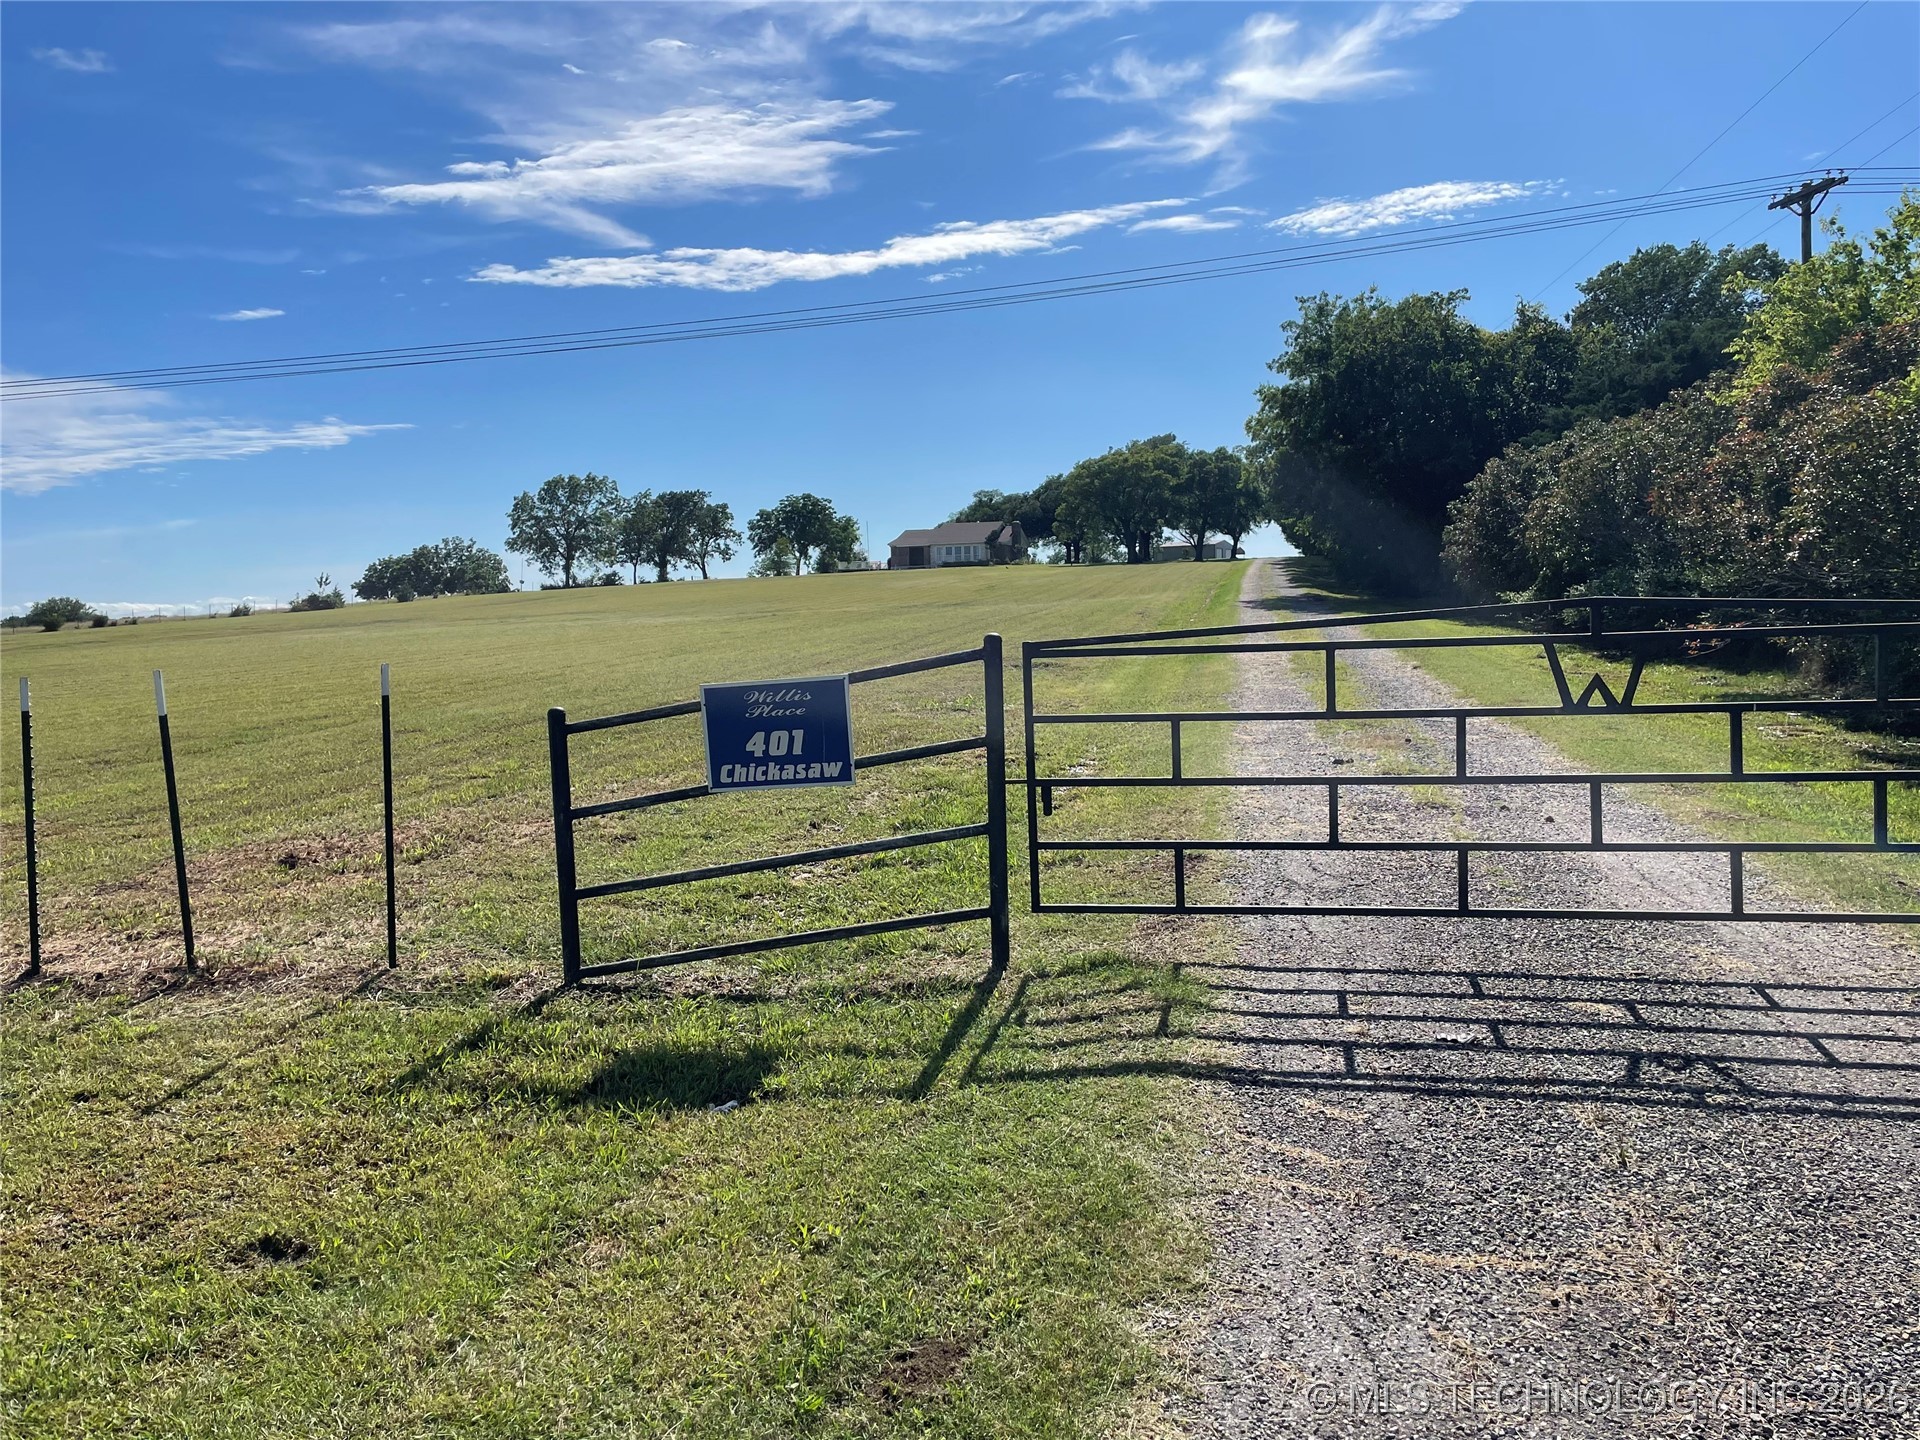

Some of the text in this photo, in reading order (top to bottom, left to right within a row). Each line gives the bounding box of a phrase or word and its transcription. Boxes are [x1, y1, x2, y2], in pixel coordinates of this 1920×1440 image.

[743, 688, 812, 704] Willis
[745, 704, 806, 719] Place
[745, 729, 804, 758] 401
[719, 761, 843, 784] Chickasaw
